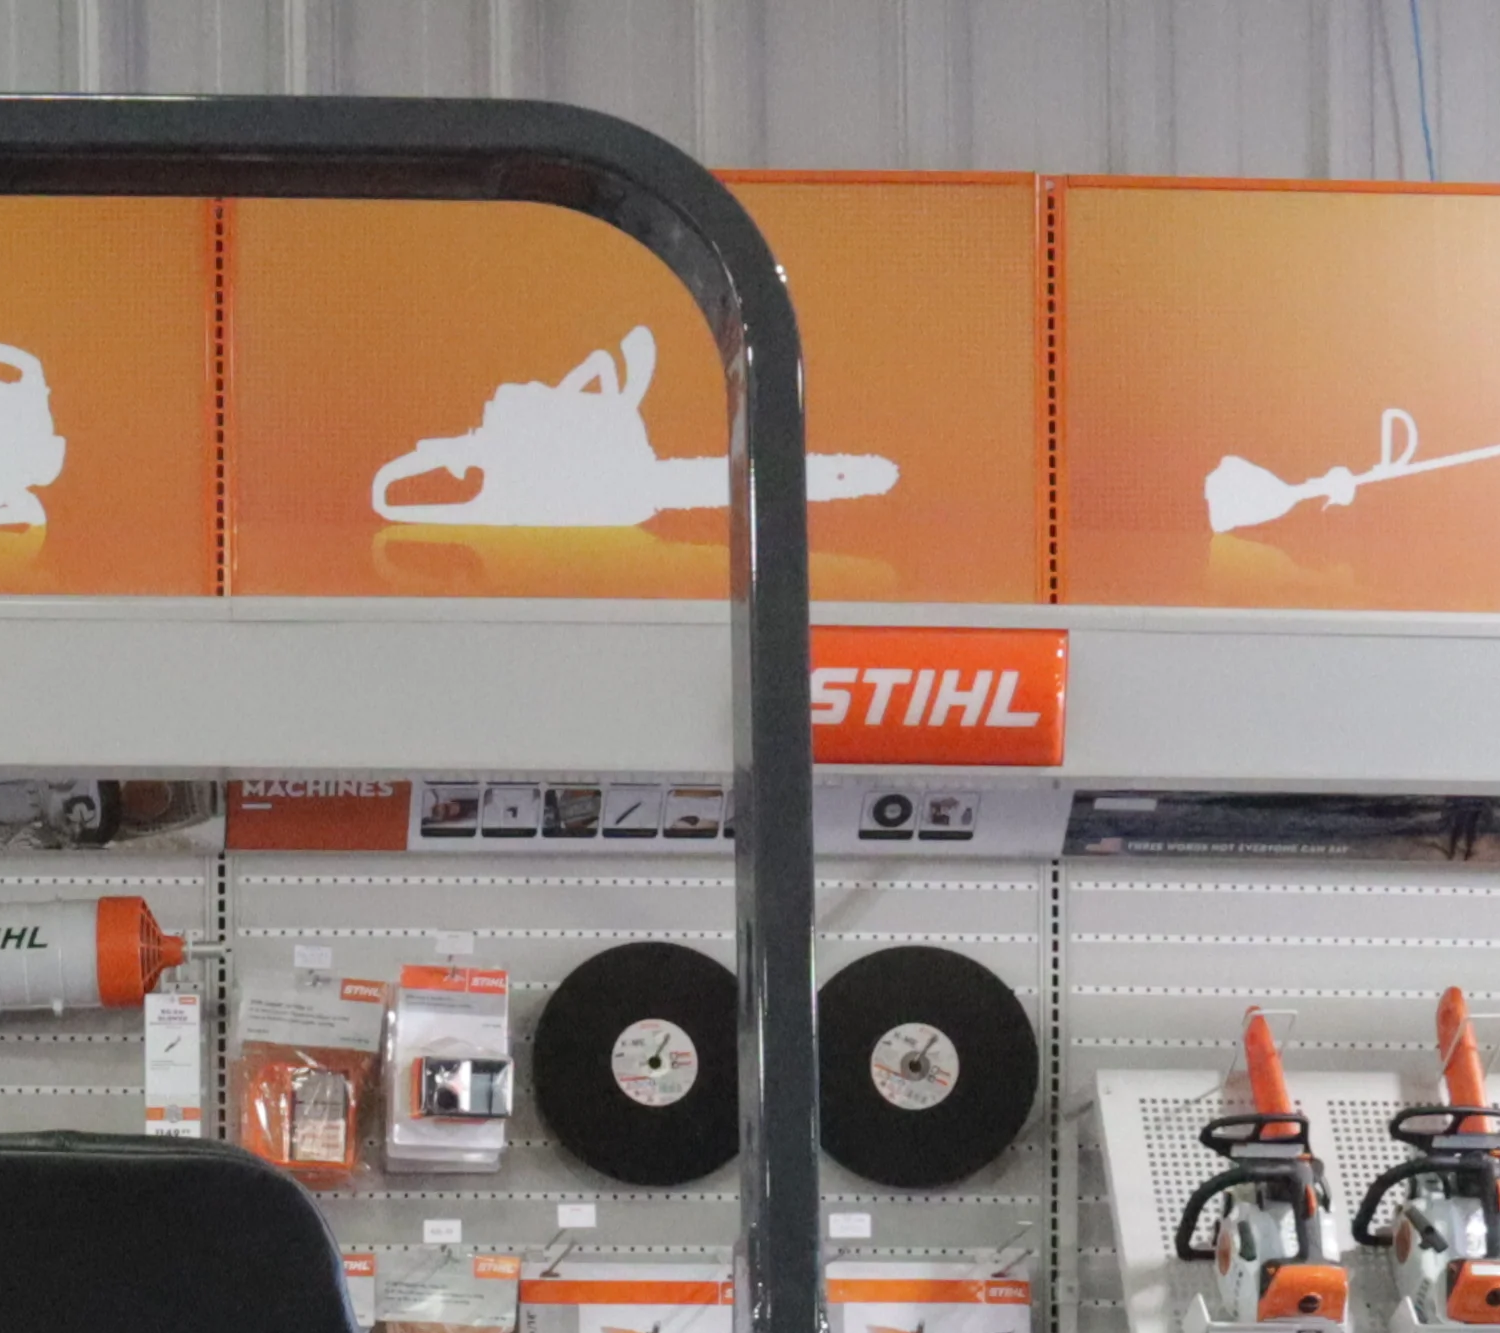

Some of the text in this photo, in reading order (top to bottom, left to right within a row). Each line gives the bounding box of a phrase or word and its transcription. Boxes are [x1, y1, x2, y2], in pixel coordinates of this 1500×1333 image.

[811, 667, 1042, 727] STIHL
[242, 780, 393, 797] MACHINES
[470, 976, 507, 989] STIHL
[343, 985, 381, 997] STIHL
[343, 1259, 372, 1271] TIHL
[475, 1261, 516, 1275] STIHL
